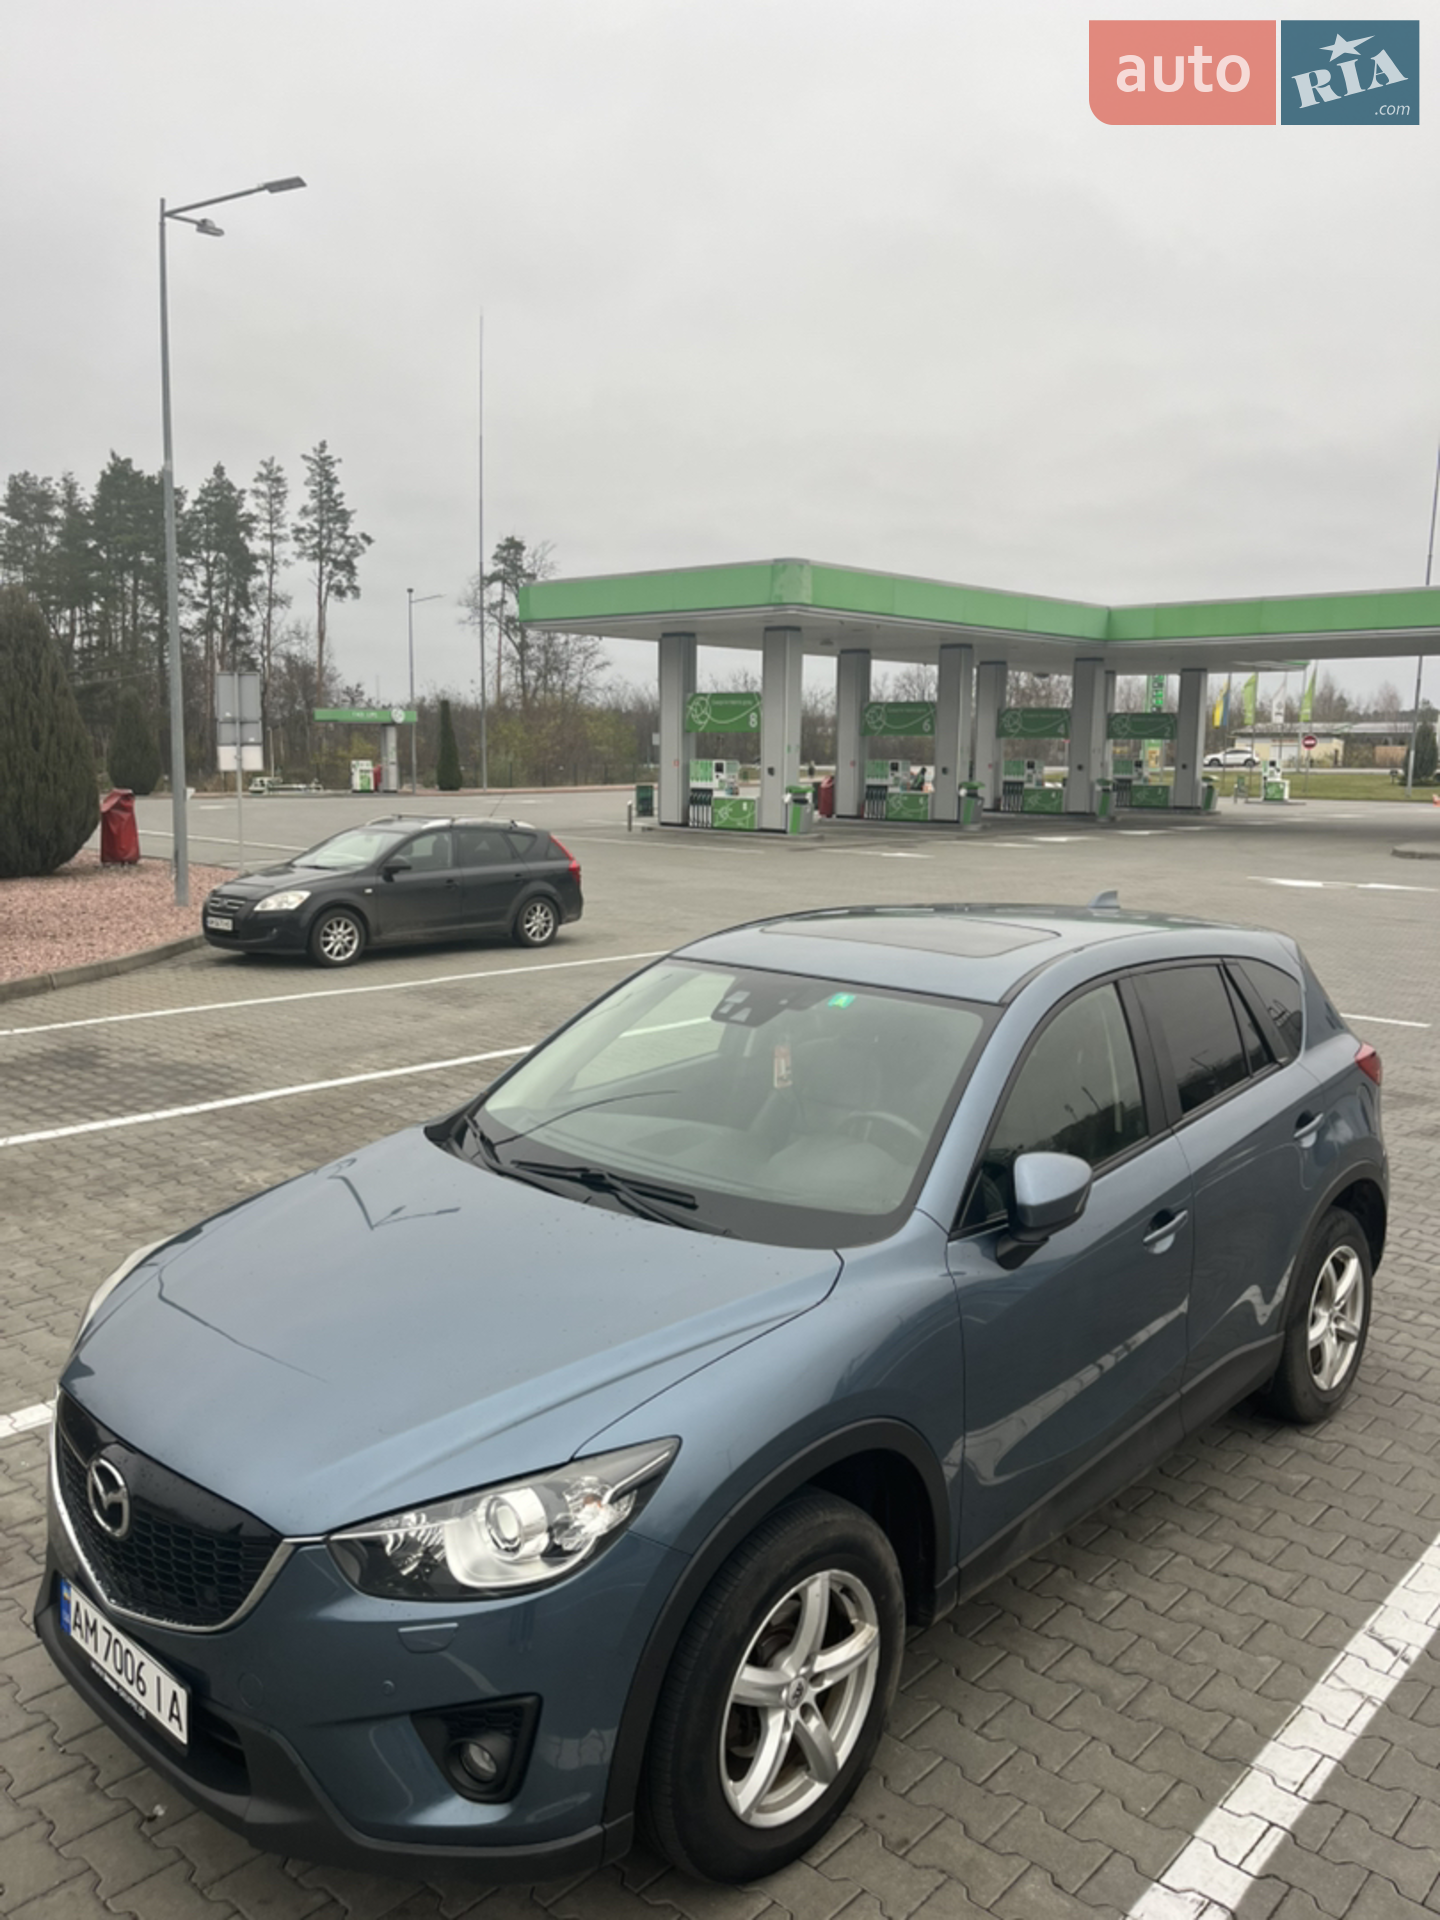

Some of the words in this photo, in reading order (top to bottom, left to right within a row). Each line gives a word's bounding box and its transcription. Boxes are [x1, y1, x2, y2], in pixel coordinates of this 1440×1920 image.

[749, 712, 758, 728] 8
[922, 717, 931, 733] 6
[1057, 722, 1066, 736] 4
[1163, 726, 1171, 737] 2
[72, 1600, 98, 1654] AM
[101, 1626, 147, 1697] 7006
[157, 1676, 183, 1734] IA
